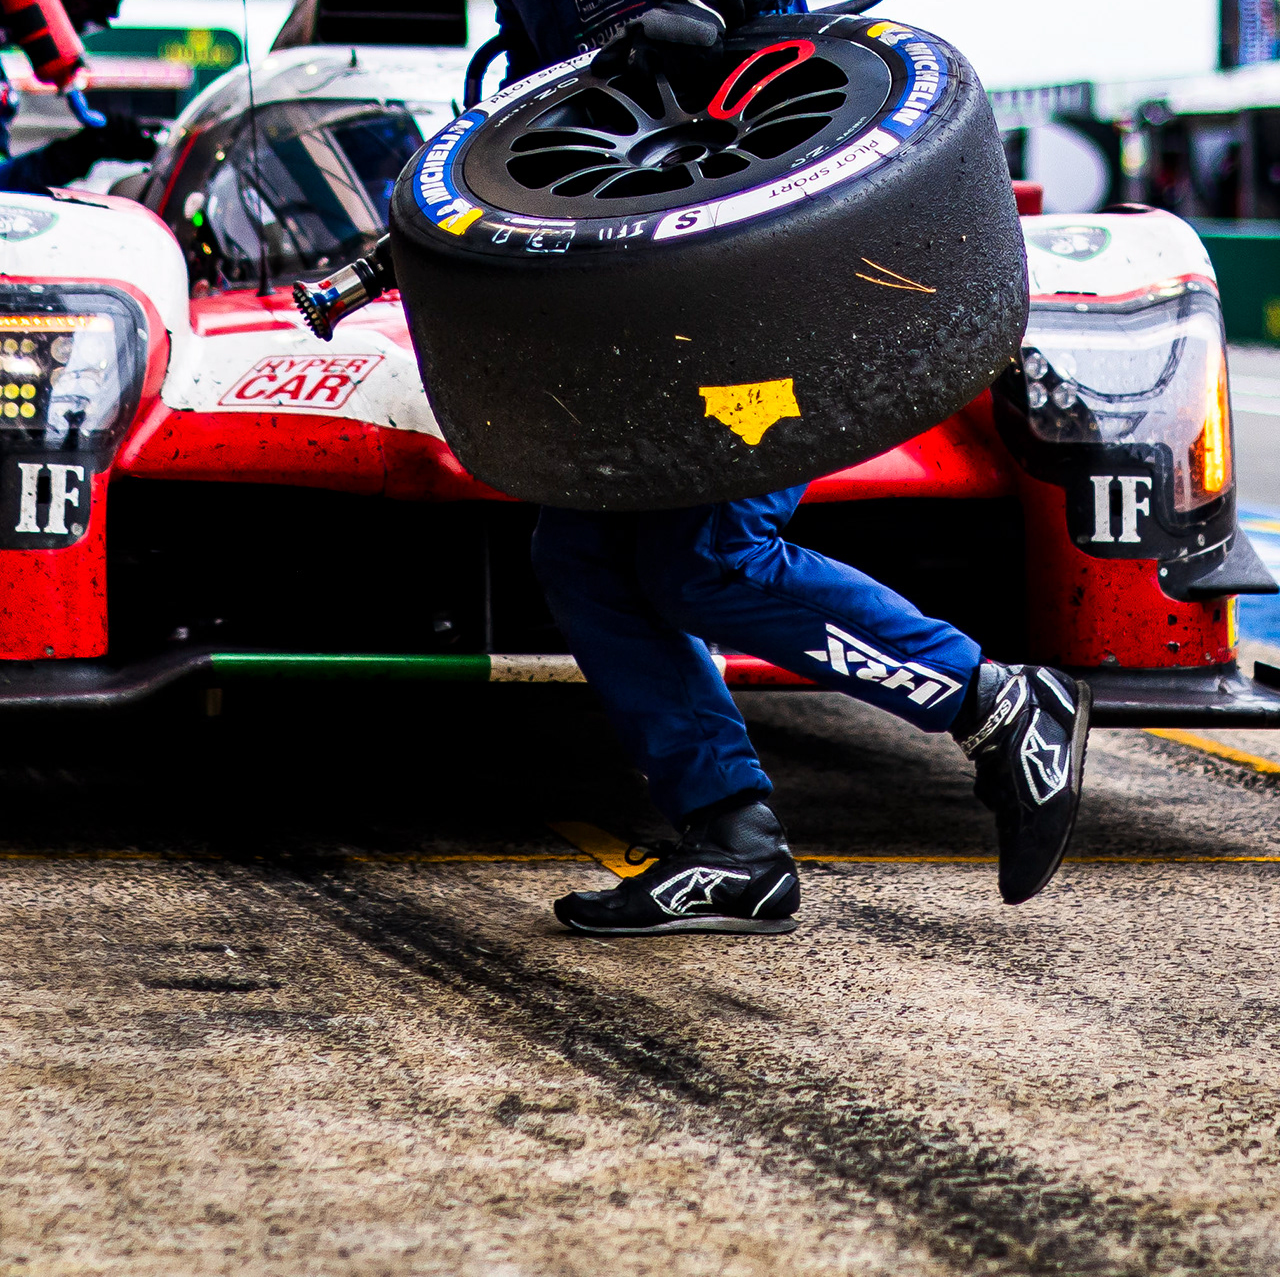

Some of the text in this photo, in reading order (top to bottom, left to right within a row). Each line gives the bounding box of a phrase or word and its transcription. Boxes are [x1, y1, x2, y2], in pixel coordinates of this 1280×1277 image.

[490, 53, 594, 104] PILOT SPORT
[892, 42, 941, 127] MICHELIN
[419, 119, 475, 206] MICHELIN
[836, 139, 880, 169] PILOT
[768, 167, 830, 199] SPORT
[674, 209, 702, 231] S
[235, 374, 351, 402] CAR
[255, 358, 370, 373] HYPER
[15, 463, 85, 534] IF
[1090, 476, 1152, 543] IF
[803, 634, 944, 706] HRX
